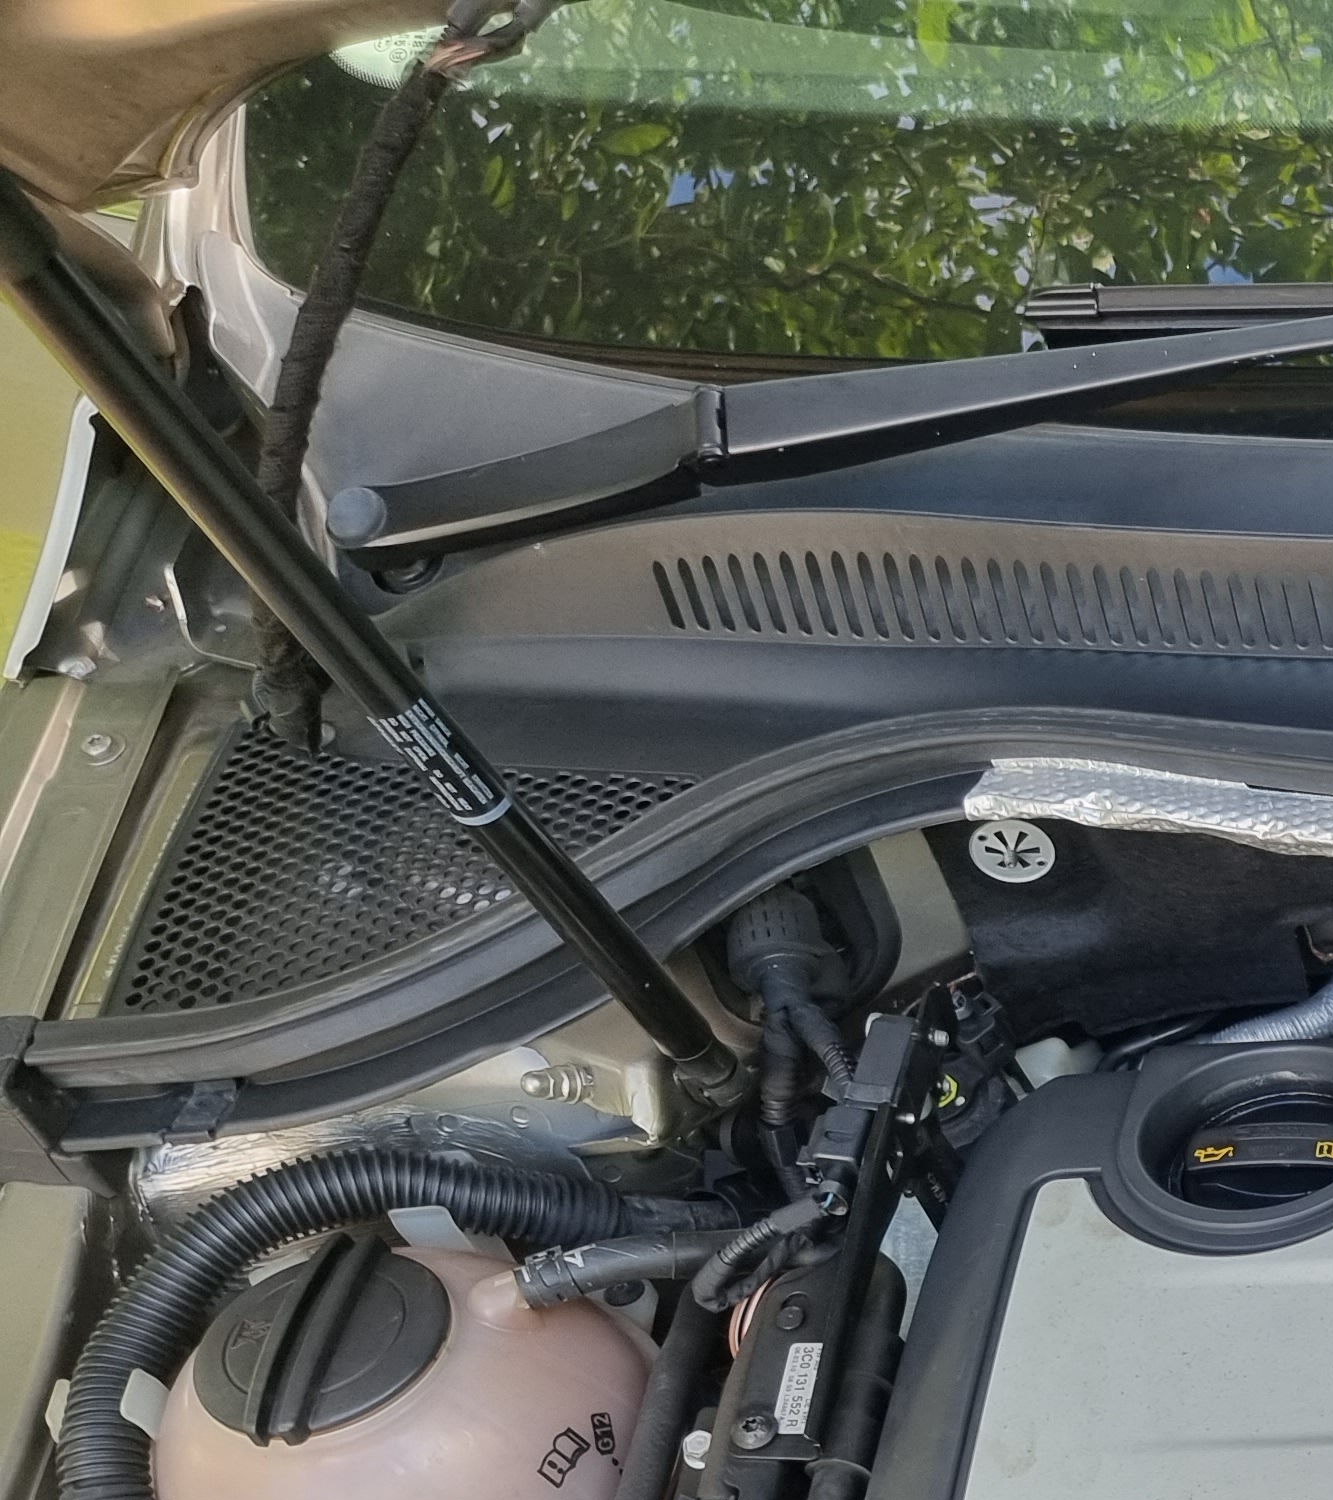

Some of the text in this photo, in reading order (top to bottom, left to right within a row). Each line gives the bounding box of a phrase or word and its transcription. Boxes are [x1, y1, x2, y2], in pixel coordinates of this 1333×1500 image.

[799, 1346, 814, 1368] 3C0
[794, 1373, 808, 1390] 131
[788, 1395, 802, 1415] 552
[593, 1414, 612, 1450] G12
